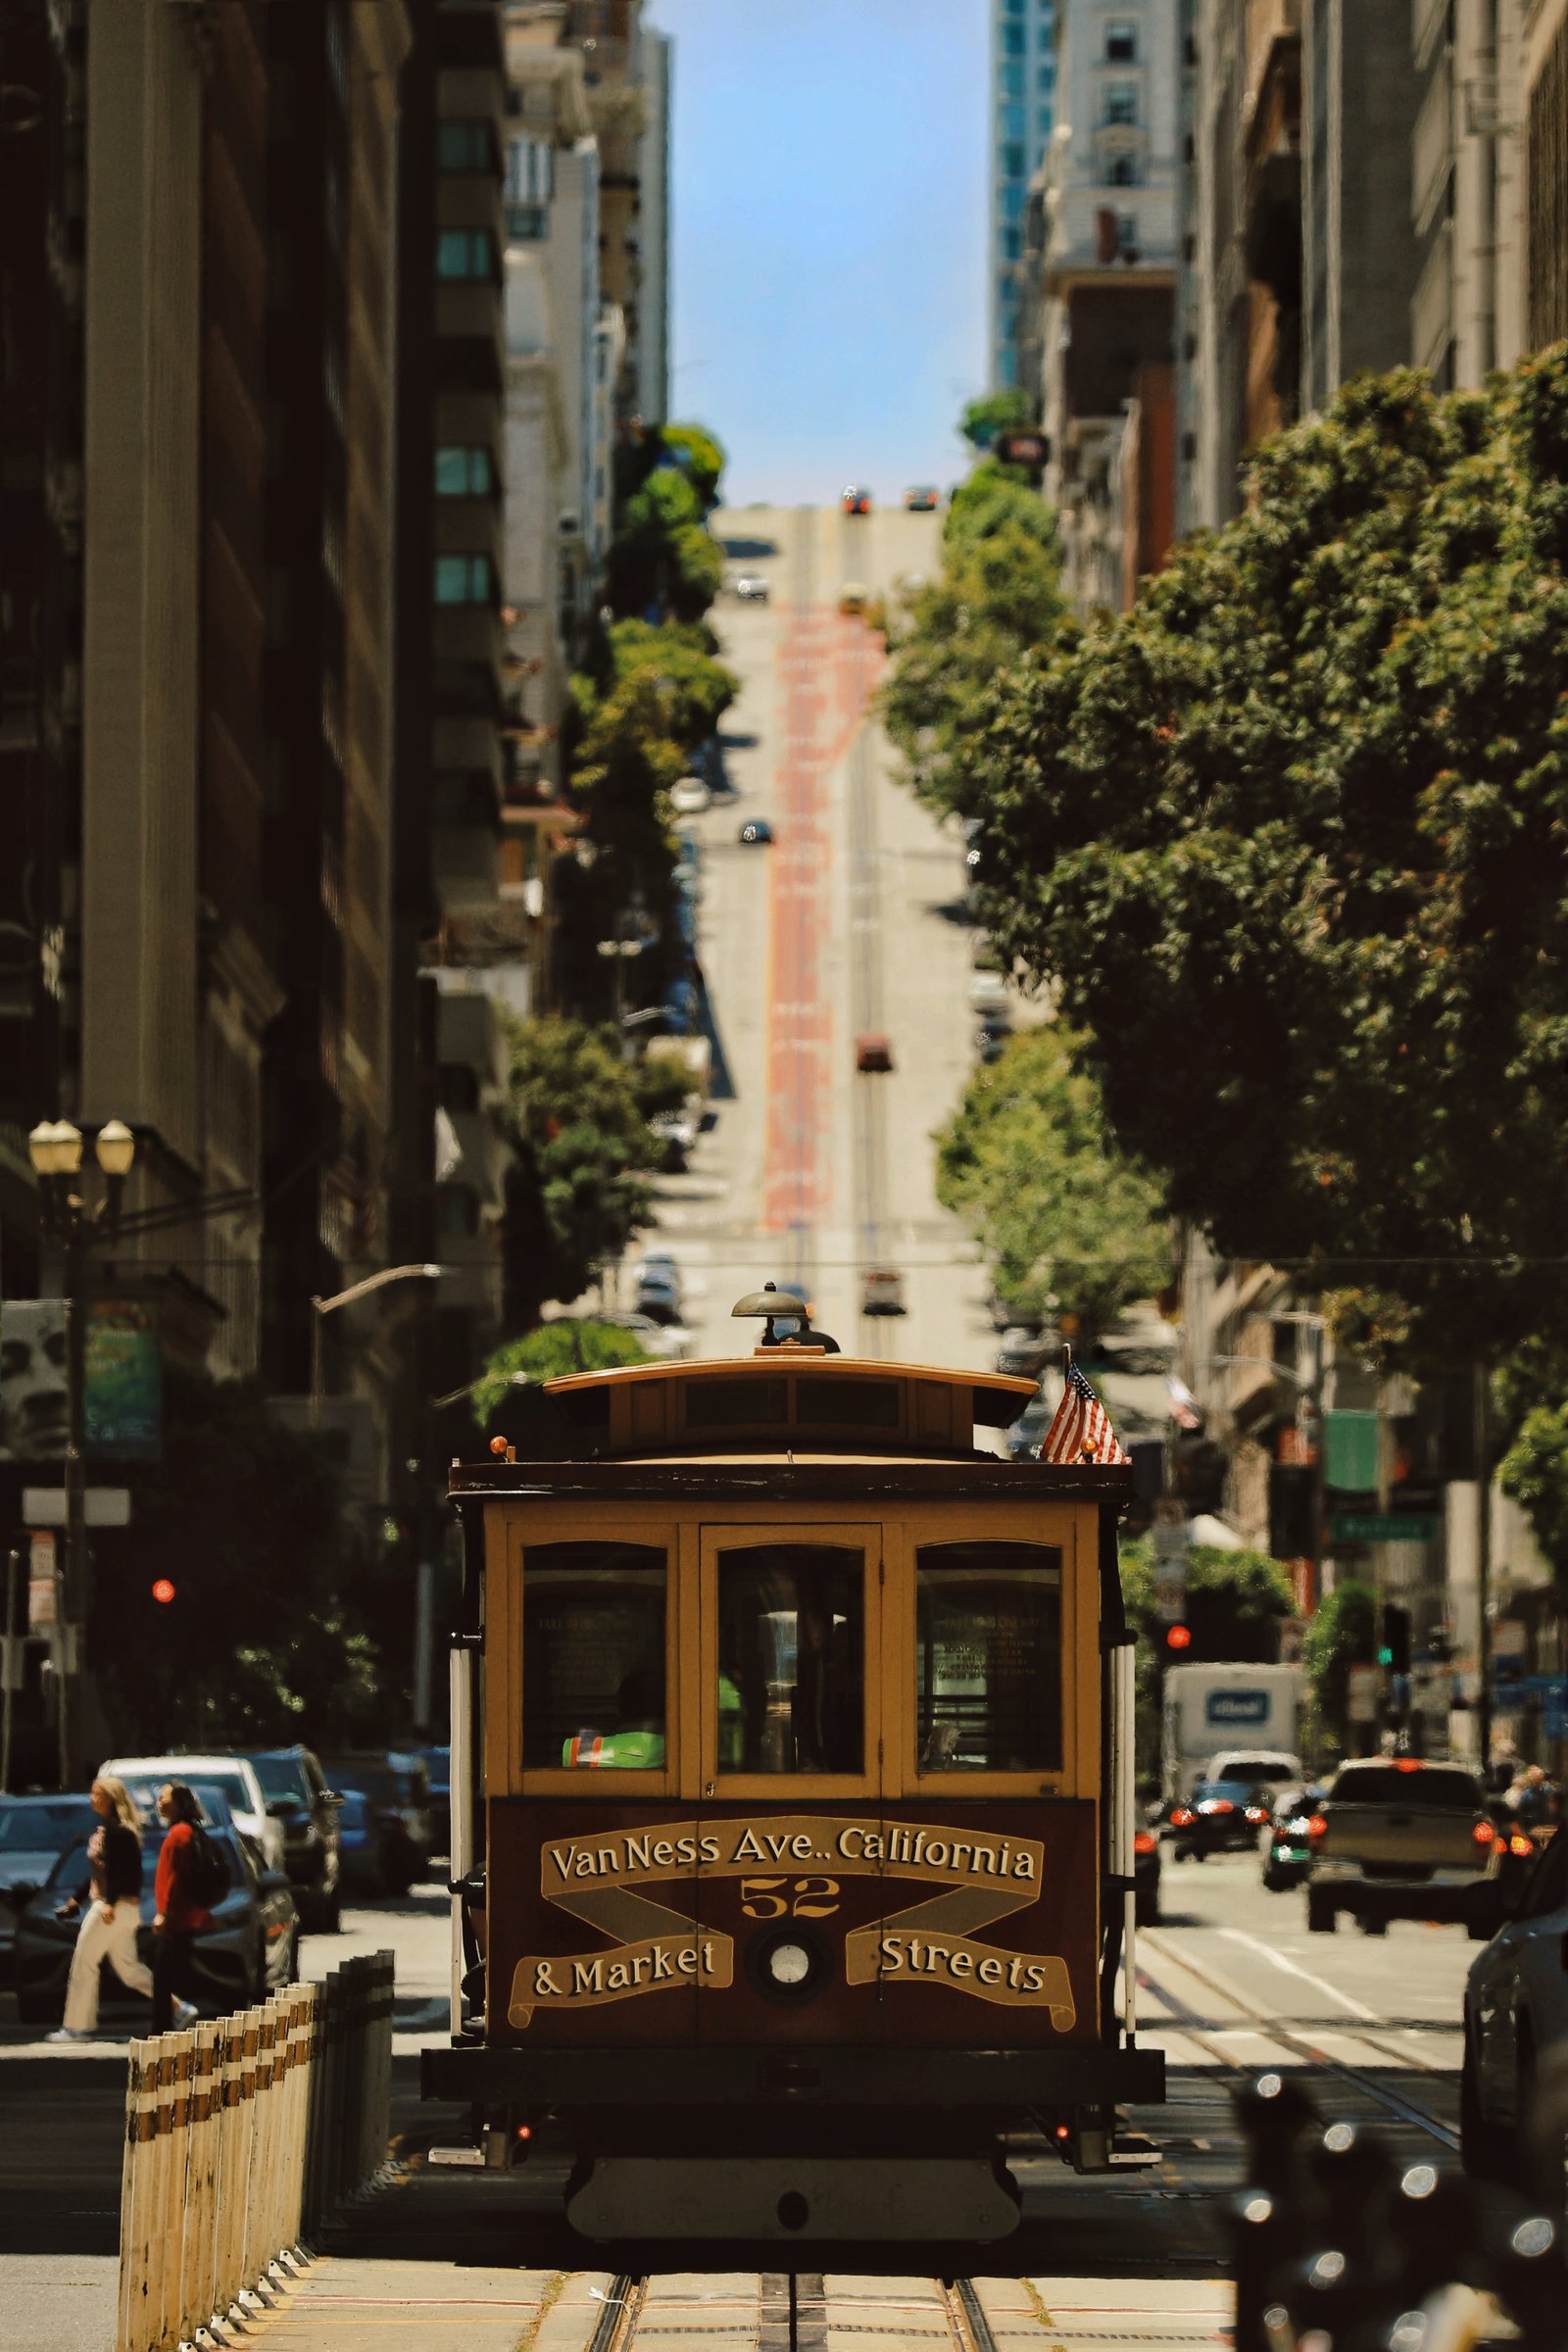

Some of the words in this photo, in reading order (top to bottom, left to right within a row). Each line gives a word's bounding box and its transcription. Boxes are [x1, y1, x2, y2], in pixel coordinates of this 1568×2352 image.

[551, 1845, 620, 1880] Van
[623, 1834, 720, 1869] Ness
[839, 1827, 1035, 1880] California
[741, 1877, 840, 1919] 52
[535, 1961, 564, 1995] &
[573, 1941, 715, 1993] Market
[881, 1937, 1047, 1990] Streets
